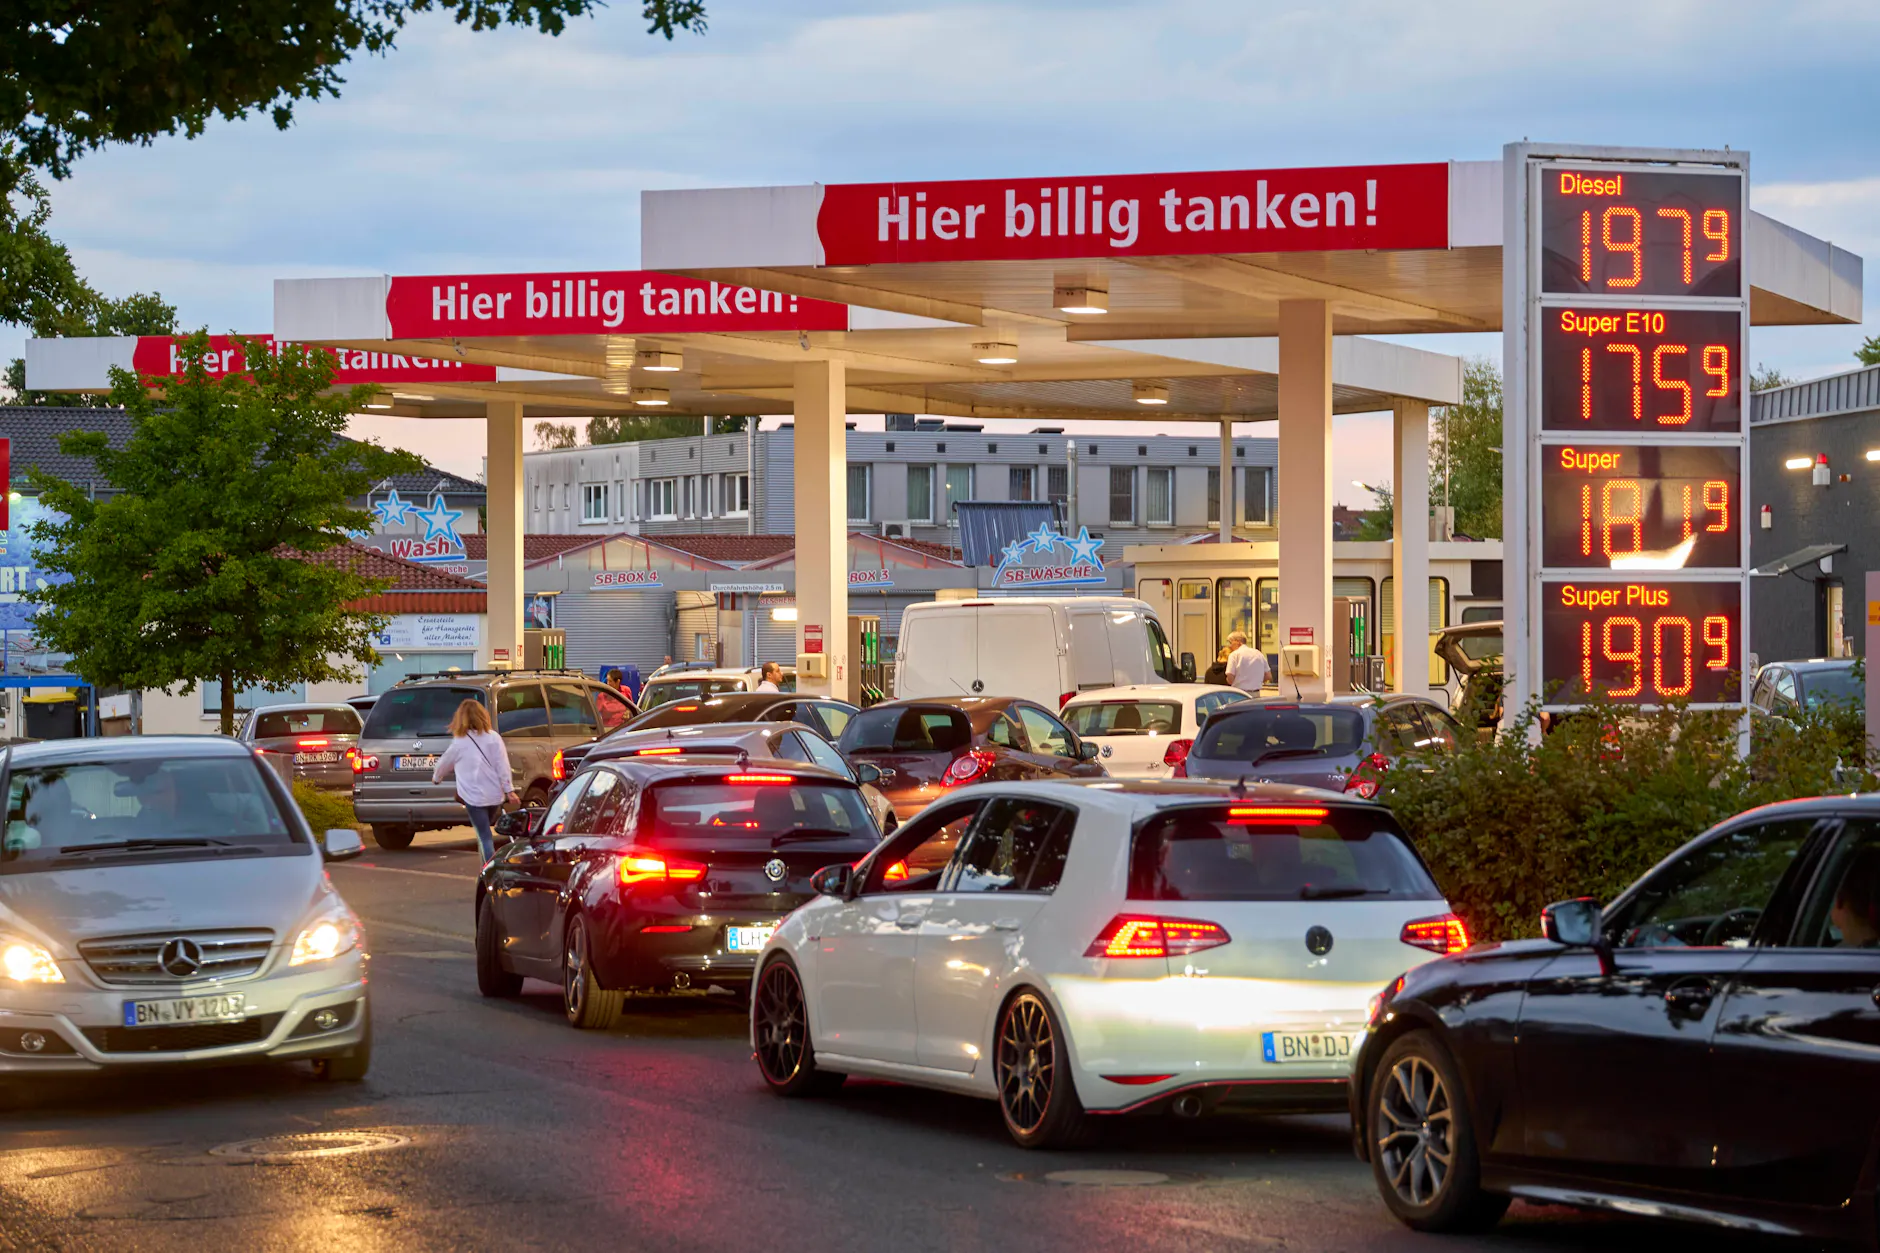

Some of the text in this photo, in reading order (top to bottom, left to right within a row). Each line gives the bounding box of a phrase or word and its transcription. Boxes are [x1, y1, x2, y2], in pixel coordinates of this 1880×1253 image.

[1560, 173, 1622, 195] Diesel
[878, 179, 1377, 248] Hier billig tanken!
[432, 282, 512, 321] Hier
[526, 278, 625, 328] billig
[1561, 311, 1665, 336] Super E10
[169, 344, 235, 373] Her
[1561, 448, 1621, 473] Super
[391, 536, 450, 557] Wash
[595, 570, 659, 585] SB-BOX 4
[880, 568, 890, 580] 3
[1004, 565, 1092, 584] SB-WÄSCHE
[712, 584, 764, 592] Durchfahrtshöhe
[1561, 585, 1669, 610] Super Plus
[295, 753, 305, 763] BN
[402, 758, 413, 767] BN
[137, 1003, 160, 1023] BN
[172, 1000, 195, 1020] VY
[1282, 1035, 1351, 1057] BN DJ
